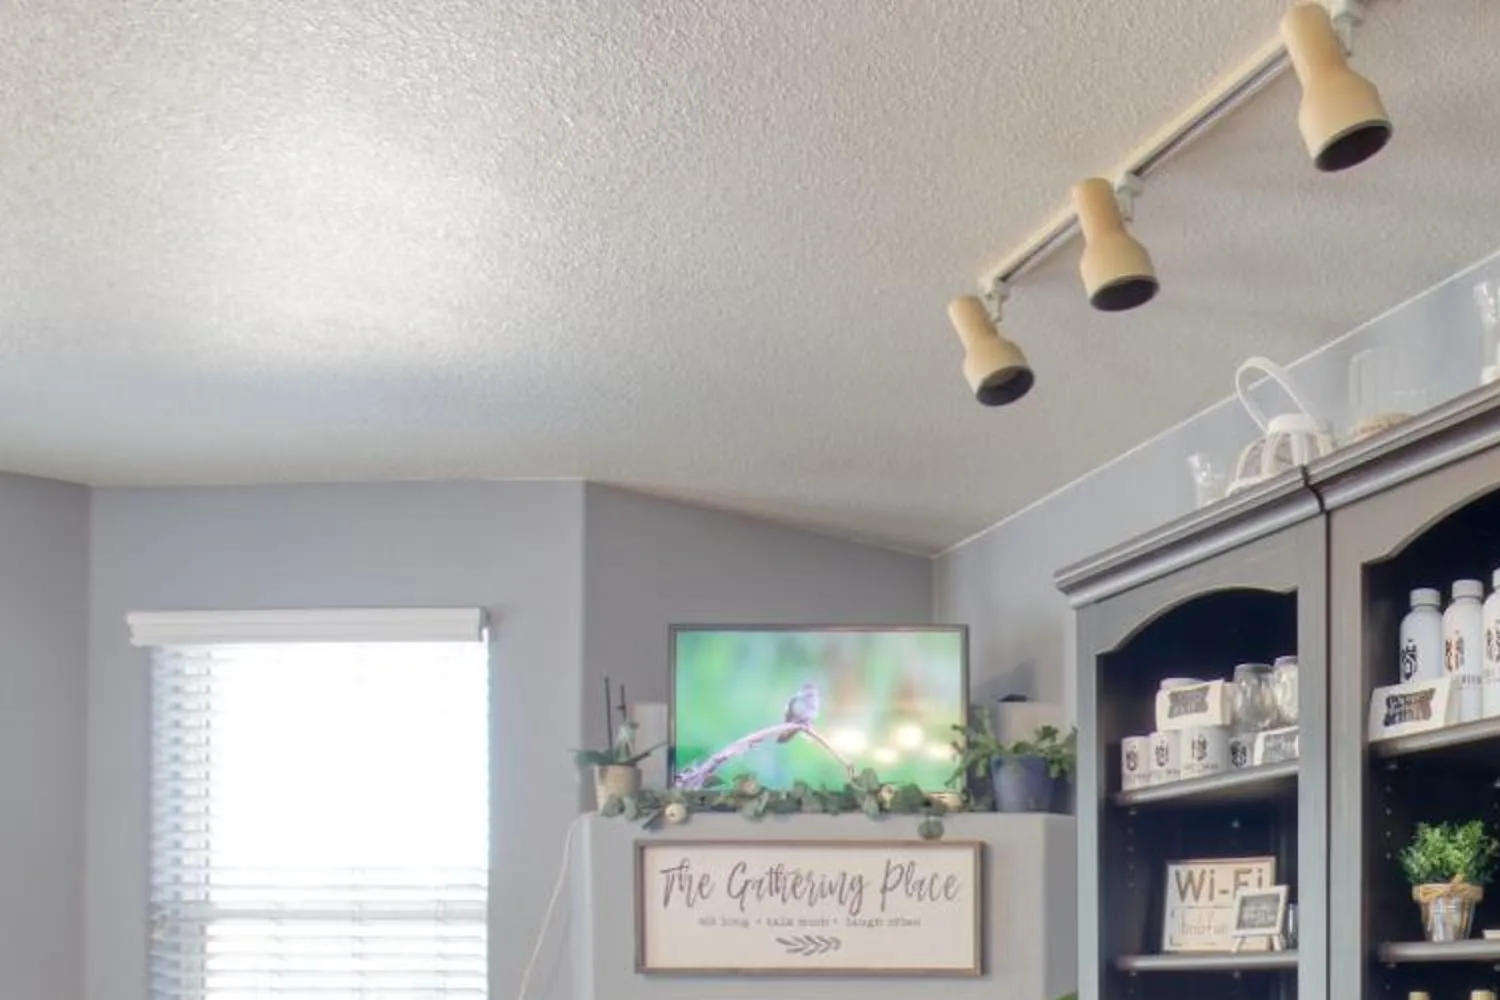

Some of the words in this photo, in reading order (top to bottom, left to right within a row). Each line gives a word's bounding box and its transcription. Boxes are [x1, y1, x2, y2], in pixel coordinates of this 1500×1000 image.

[660, 857, 715, 908] The
[727, 861, 871, 916] Gathering
[880, 858, 961, 912] Place
[1174, 867, 1264, 903] Wi-Fi
